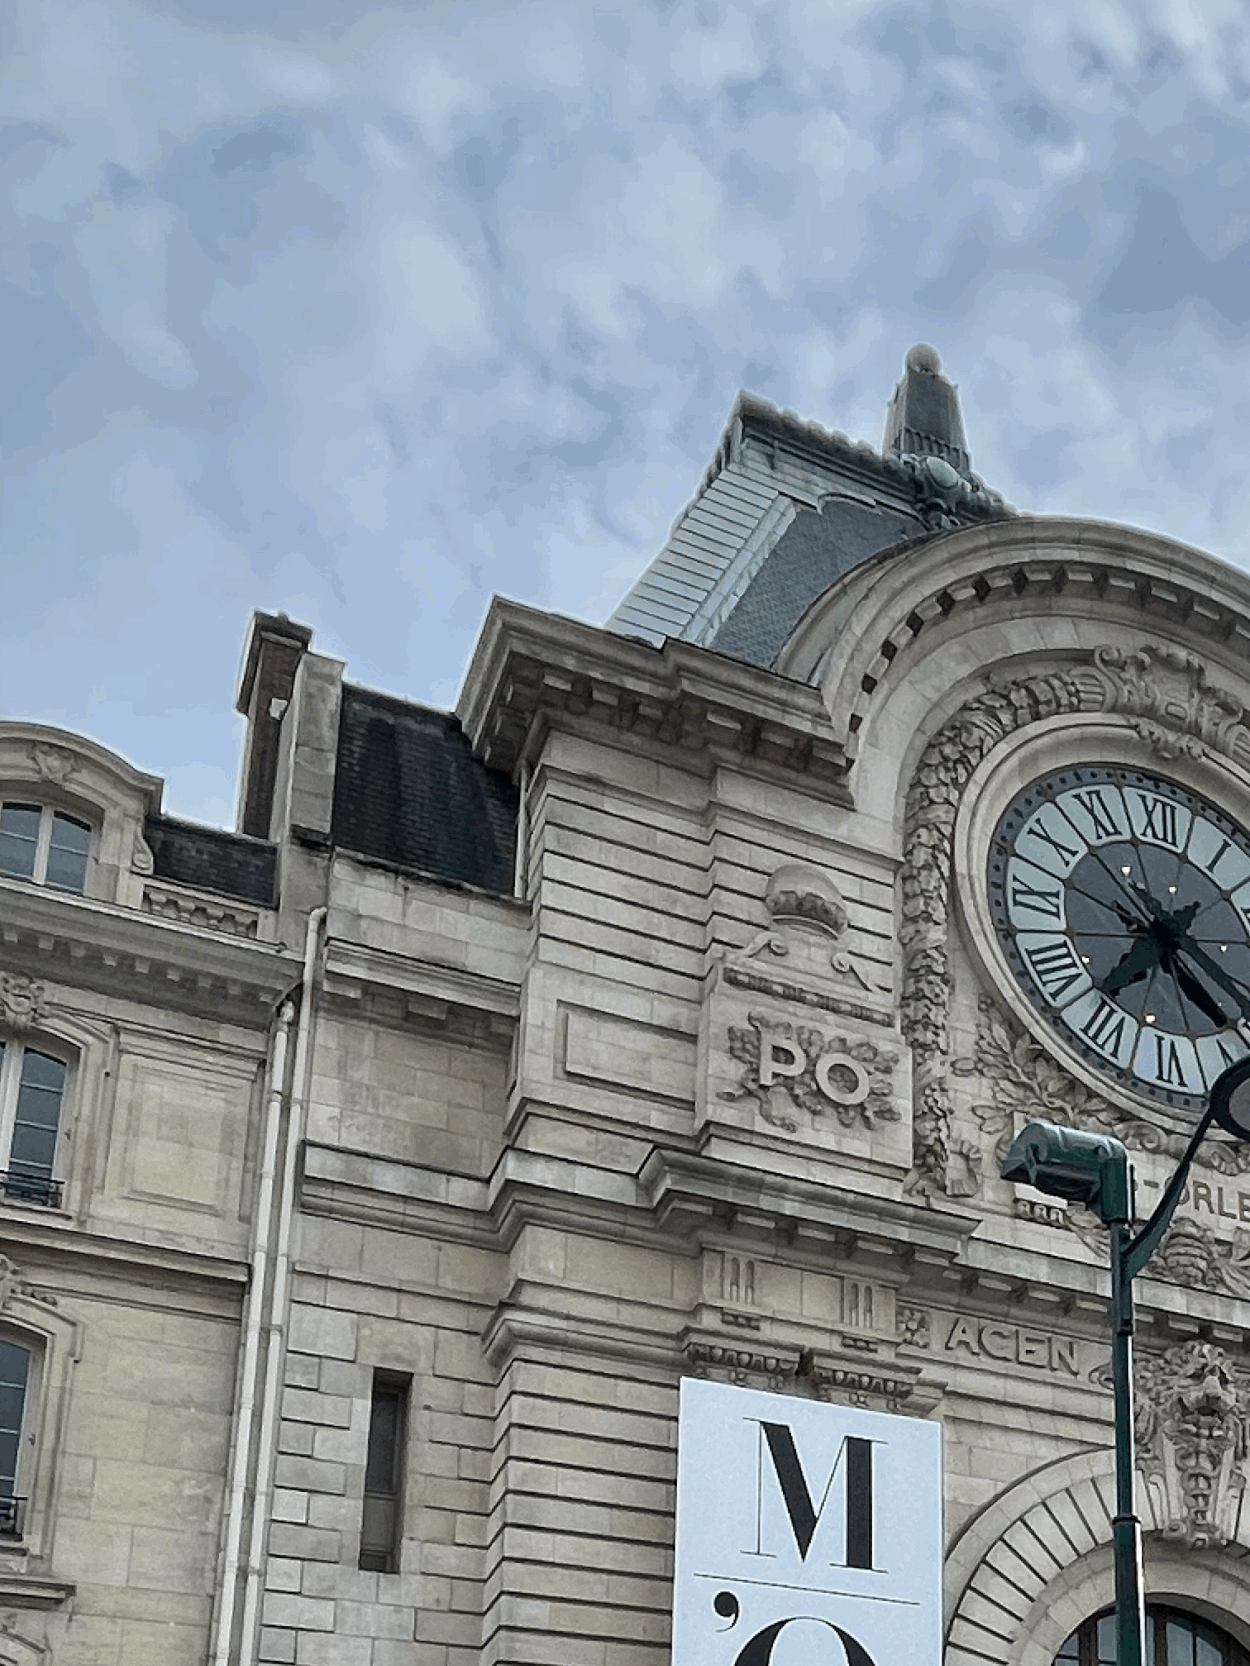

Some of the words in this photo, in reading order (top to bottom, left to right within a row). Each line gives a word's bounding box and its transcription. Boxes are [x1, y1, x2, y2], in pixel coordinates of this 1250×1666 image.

[1027, 817, 1080, 867] X
[1072, 790, 1123, 839] XI
[1138, 793, 1177, 848] XII
[1205, 839, 1232, 873] I
[1012, 874, 1061, 920] IX
[1025, 939, 1083, 1003] VIII
[1079, 998, 1126, 1061] VII
[759, 1034, 870, 1106] PO
[1155, 1033, 1189, 1088] VI
[740, 1417, 889, 1573] M
